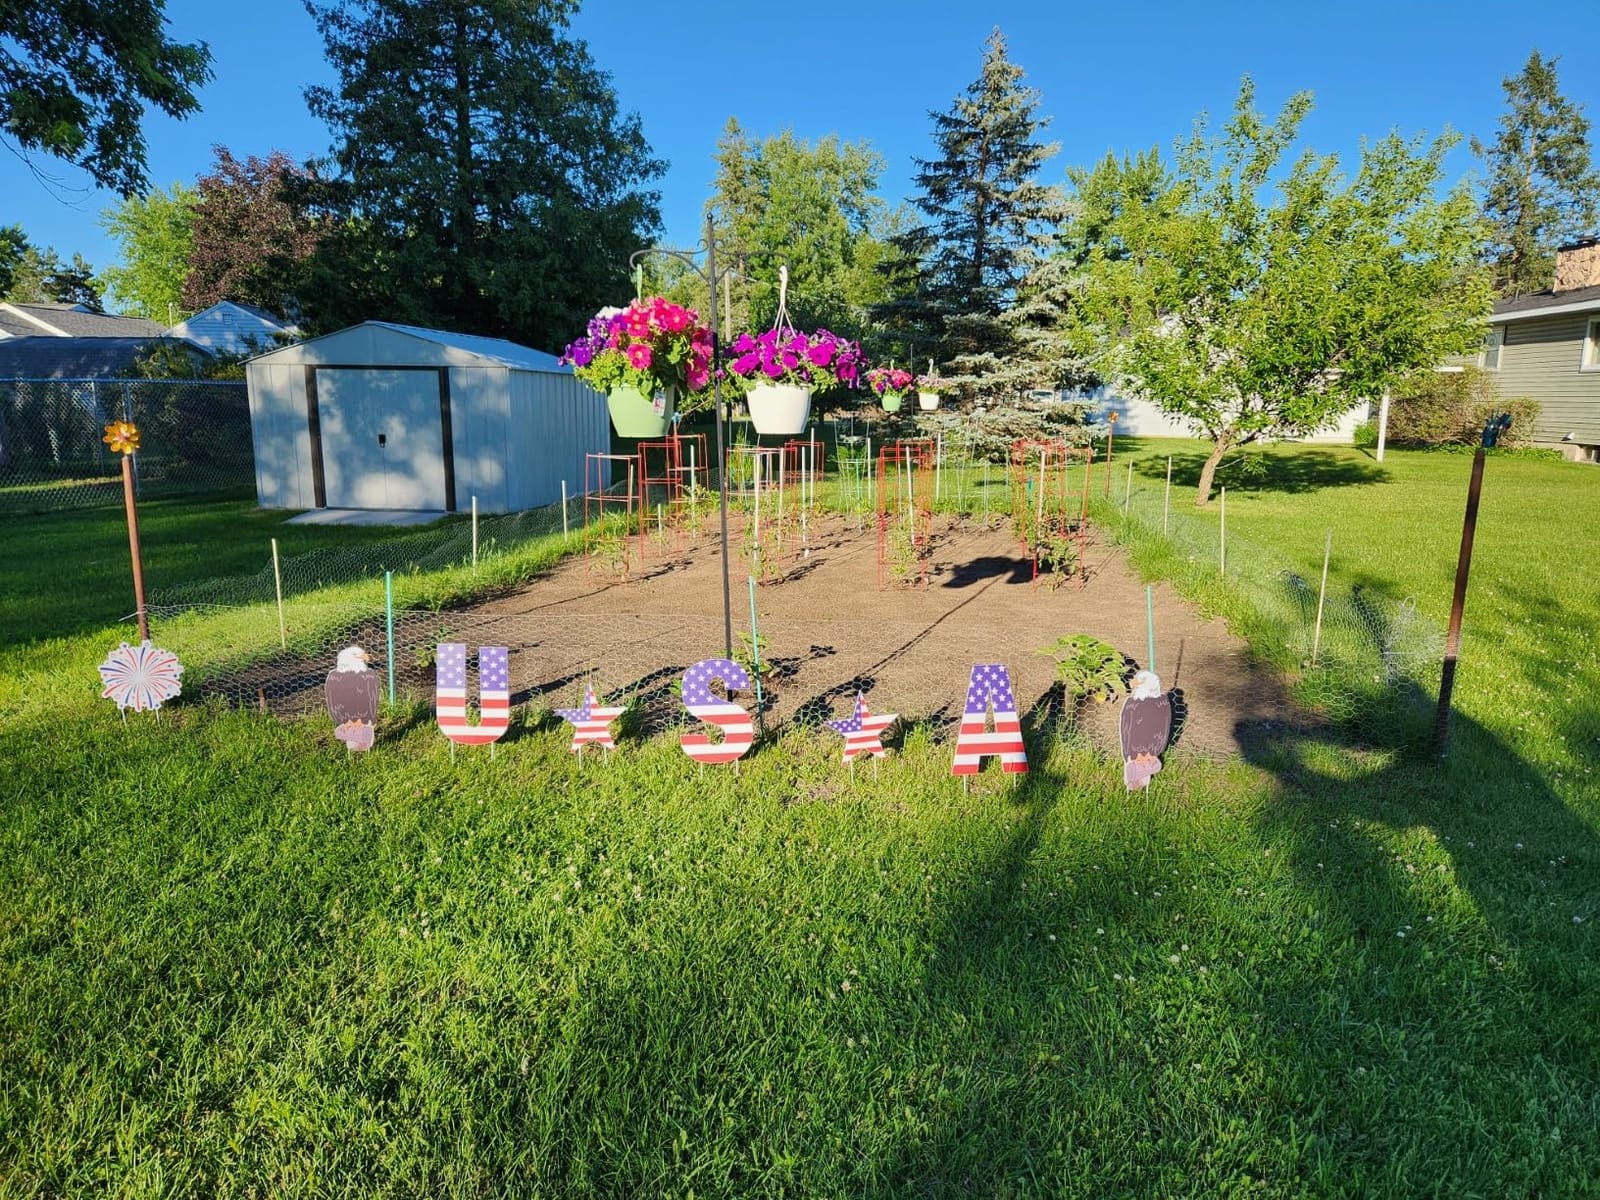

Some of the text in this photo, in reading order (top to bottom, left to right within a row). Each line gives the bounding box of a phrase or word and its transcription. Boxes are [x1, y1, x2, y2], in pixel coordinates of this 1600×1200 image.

[436, 643, 1029, 776] U S A
